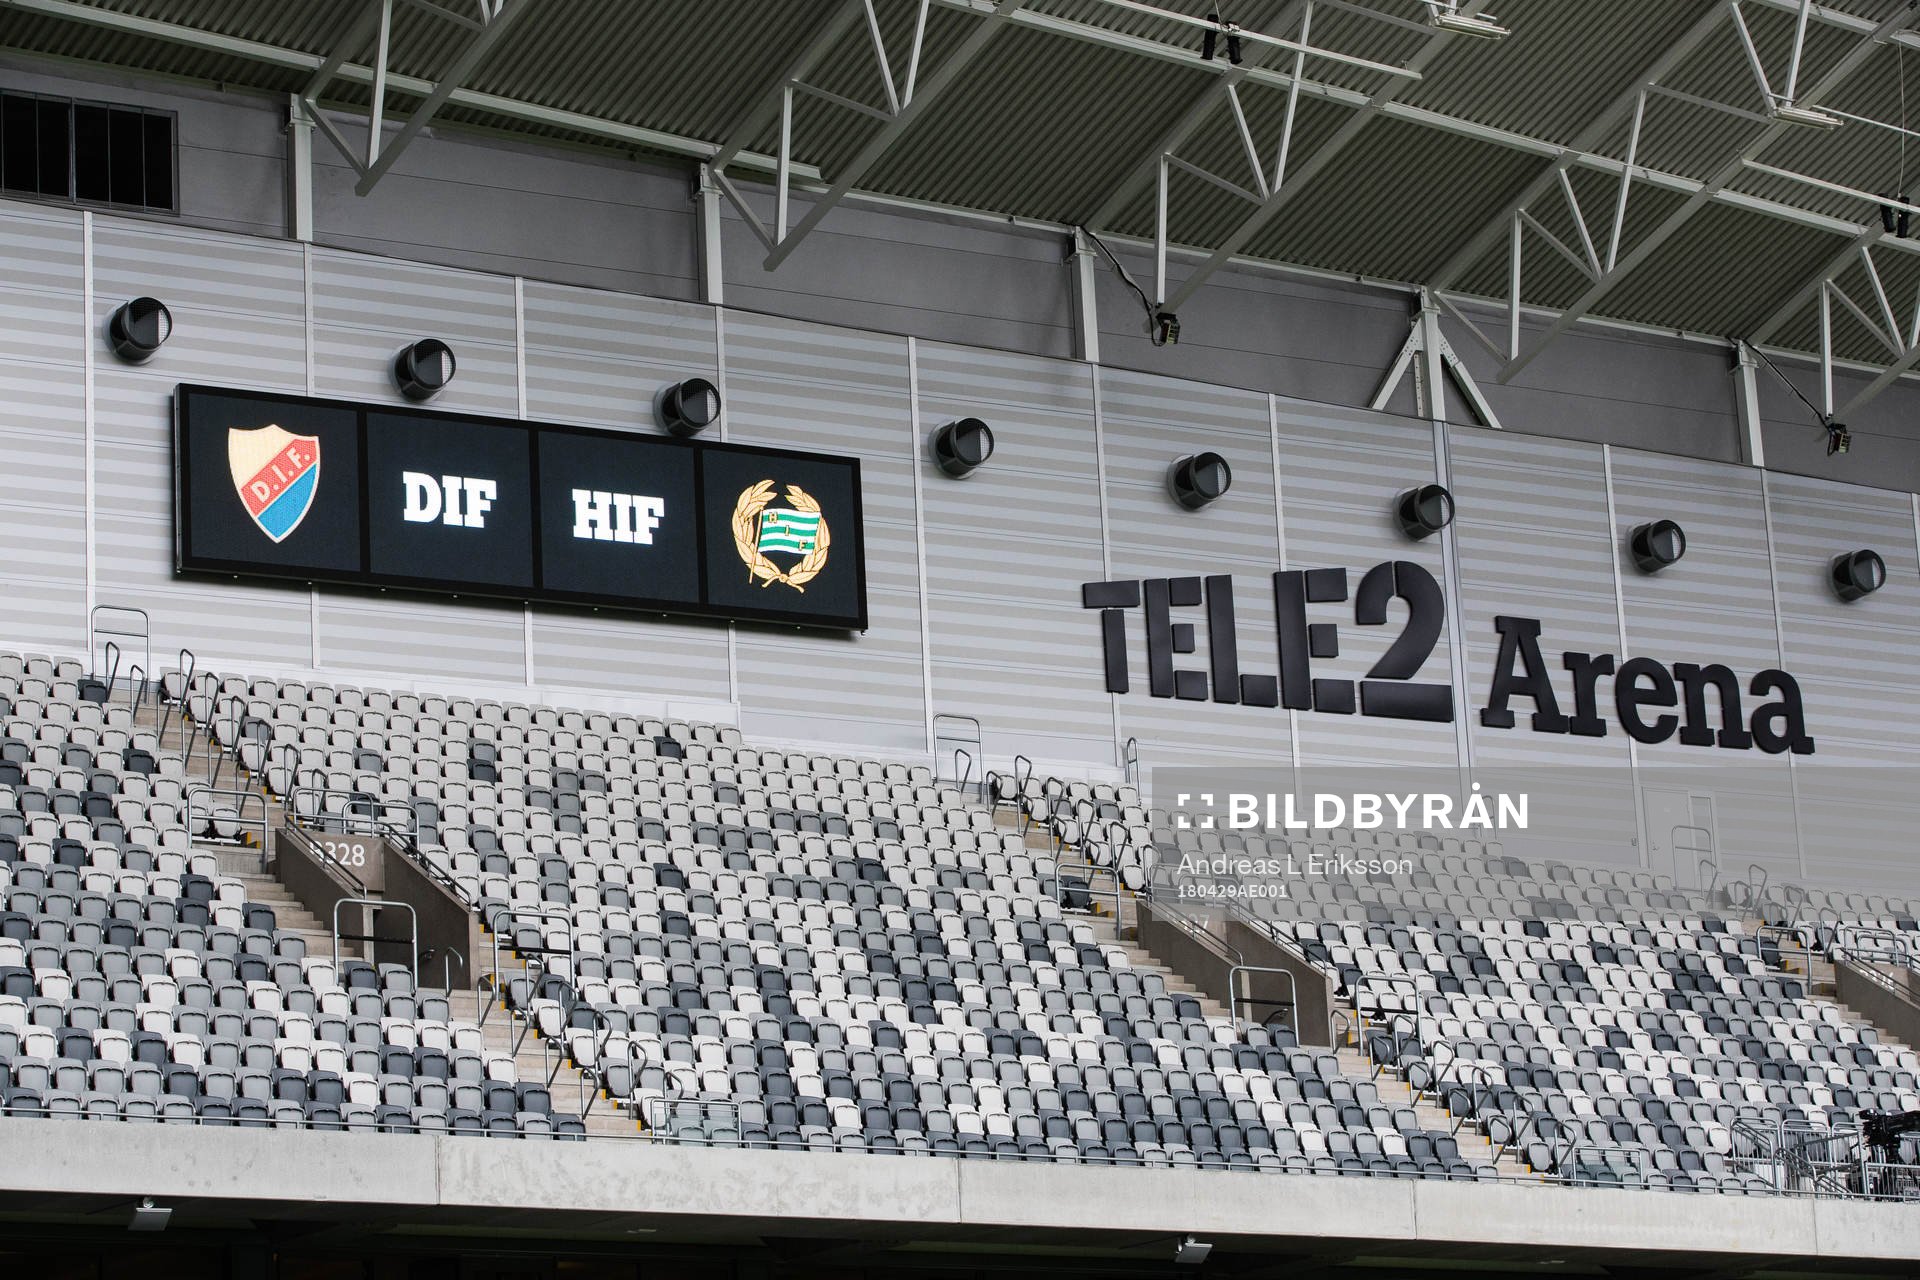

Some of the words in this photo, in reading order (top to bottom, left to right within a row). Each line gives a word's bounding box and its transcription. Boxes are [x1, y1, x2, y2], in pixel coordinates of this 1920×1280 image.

[251, 447, 311, 503] D.I.F.
[402, 471, 497, 528] DIF
[572, 488, 665, 545] HIF
[1082, 560, 1454, 722] TELE2
[1480, 615, 1816, 755] Arena
